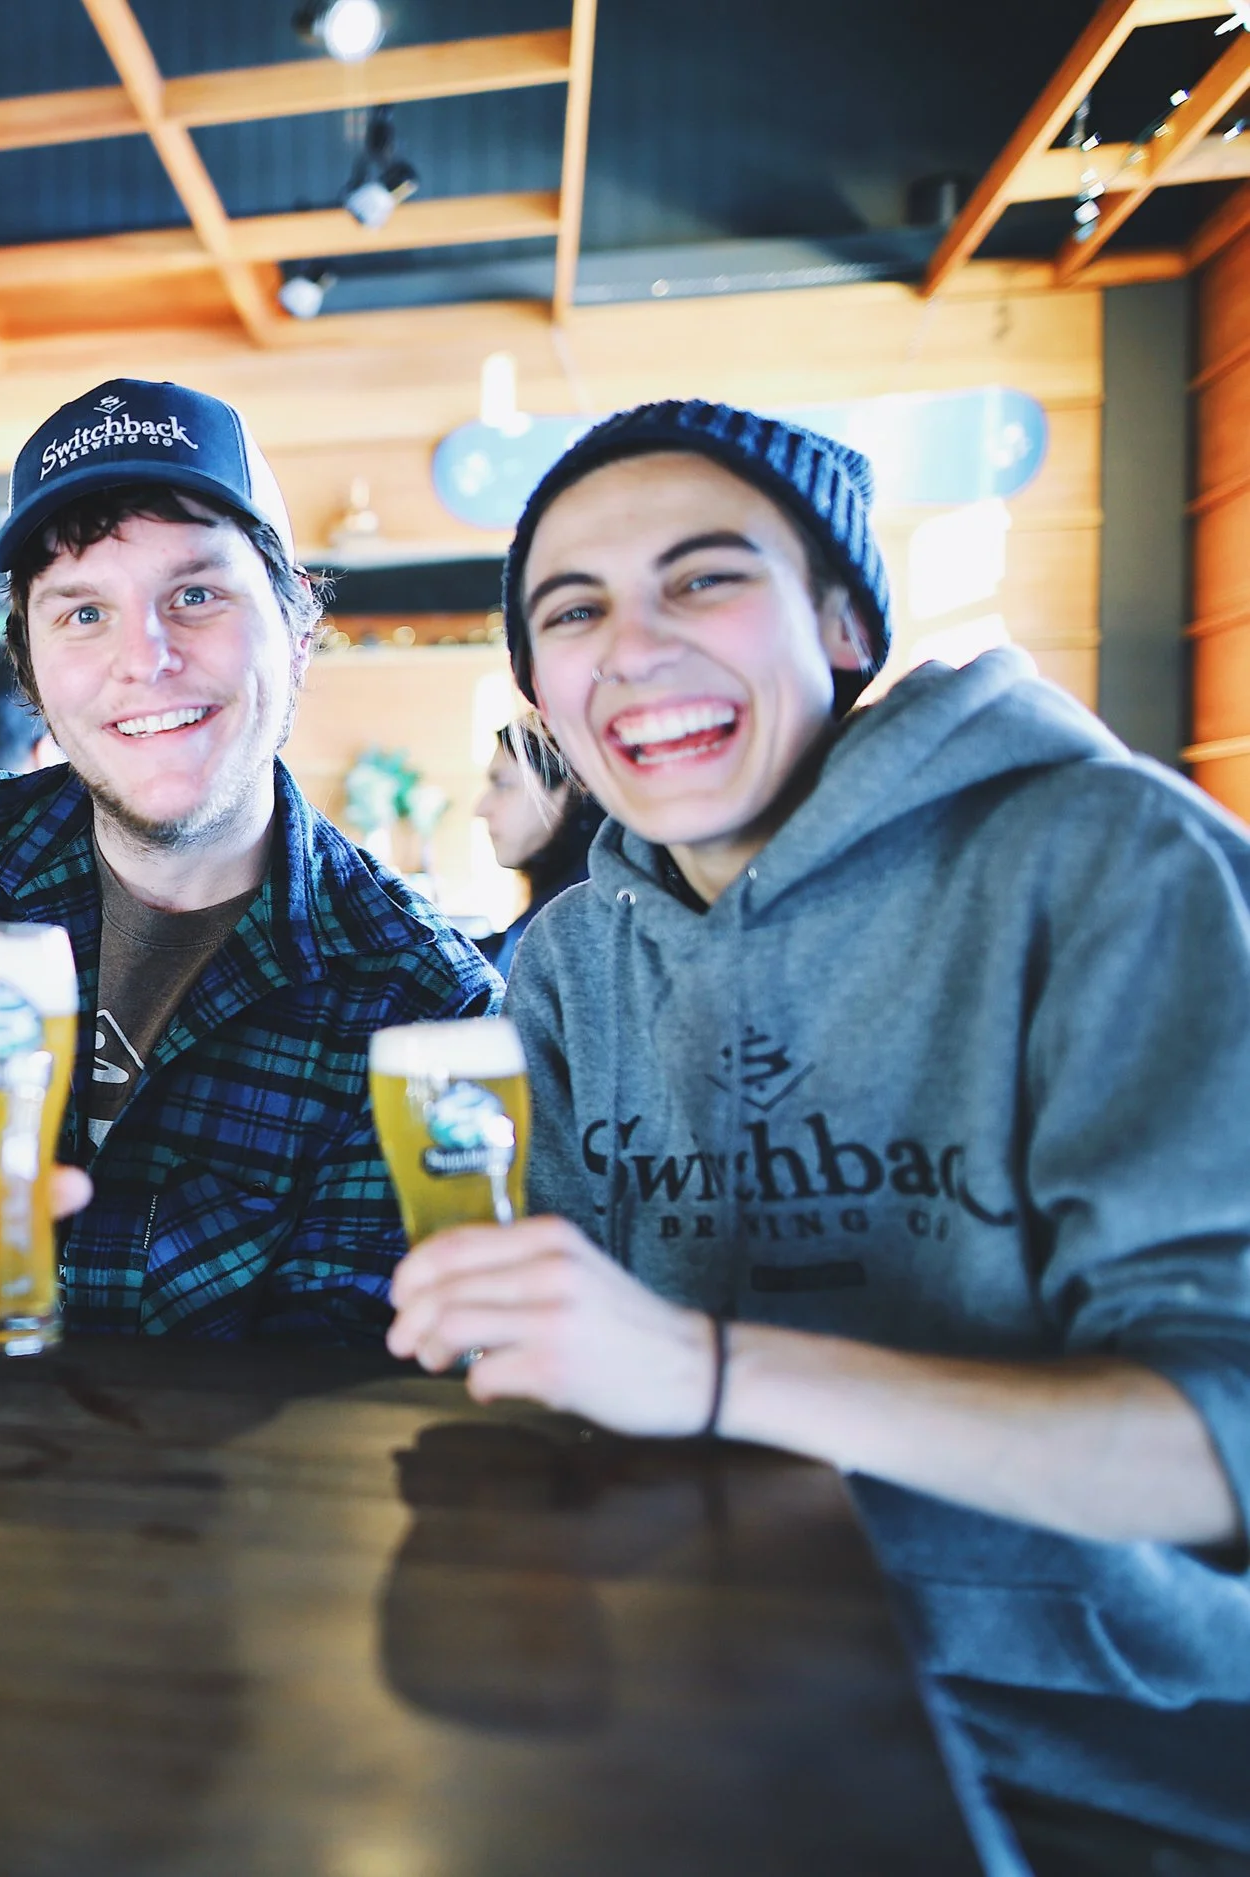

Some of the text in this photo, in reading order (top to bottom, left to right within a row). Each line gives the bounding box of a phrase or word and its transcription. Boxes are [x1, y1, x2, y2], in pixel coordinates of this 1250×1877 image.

[39, 412, 199, 481] Switchback
[58, 433, 175, 469] BREWING CO
